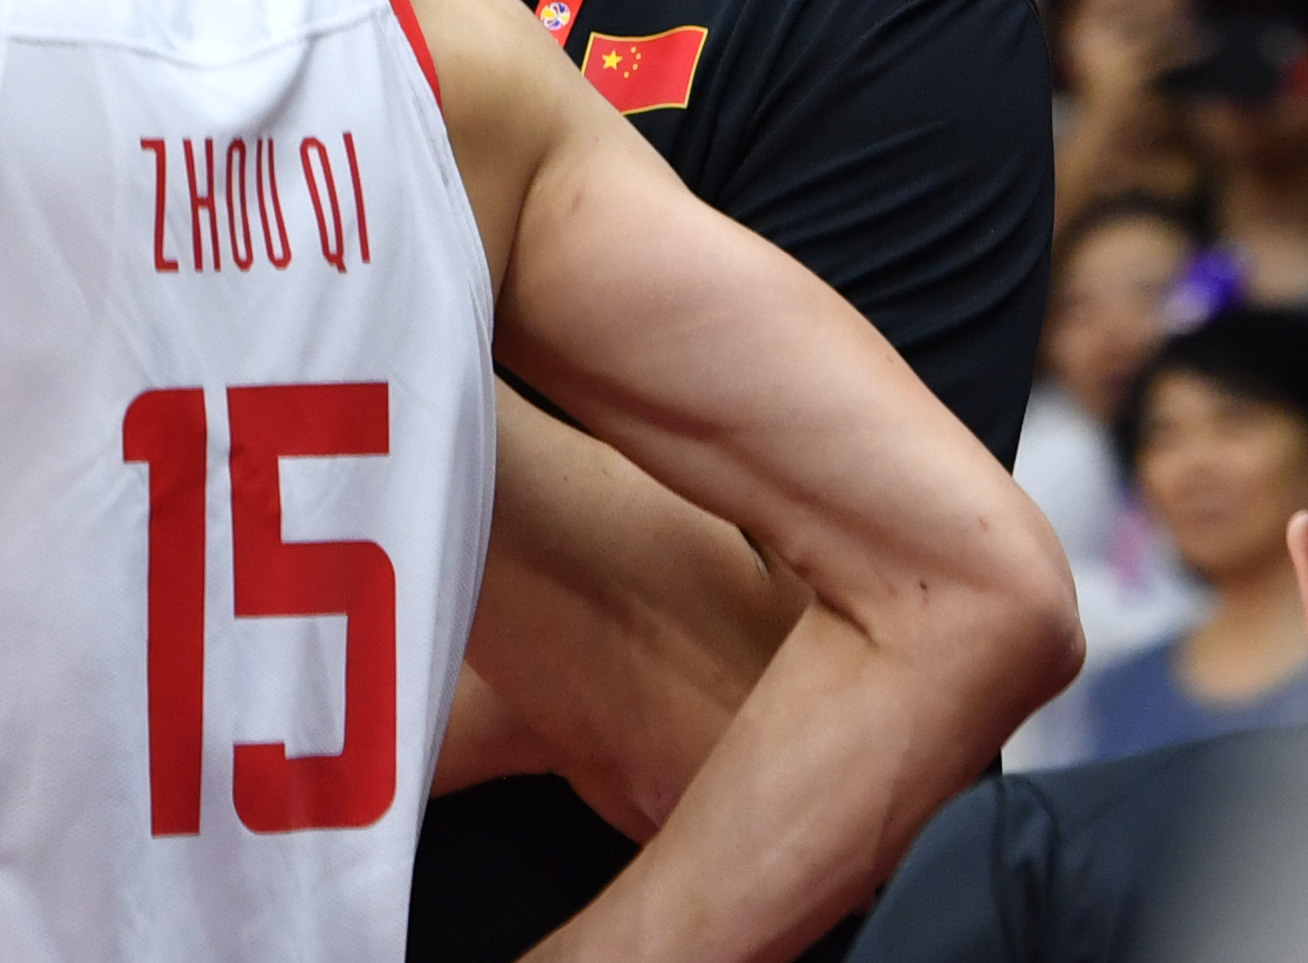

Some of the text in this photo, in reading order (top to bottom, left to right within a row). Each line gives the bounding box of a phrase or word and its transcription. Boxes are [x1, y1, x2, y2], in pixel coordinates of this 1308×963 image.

[141, 132, 370, 273] ZHOU QI
[122, 381, 396, 839] 15
